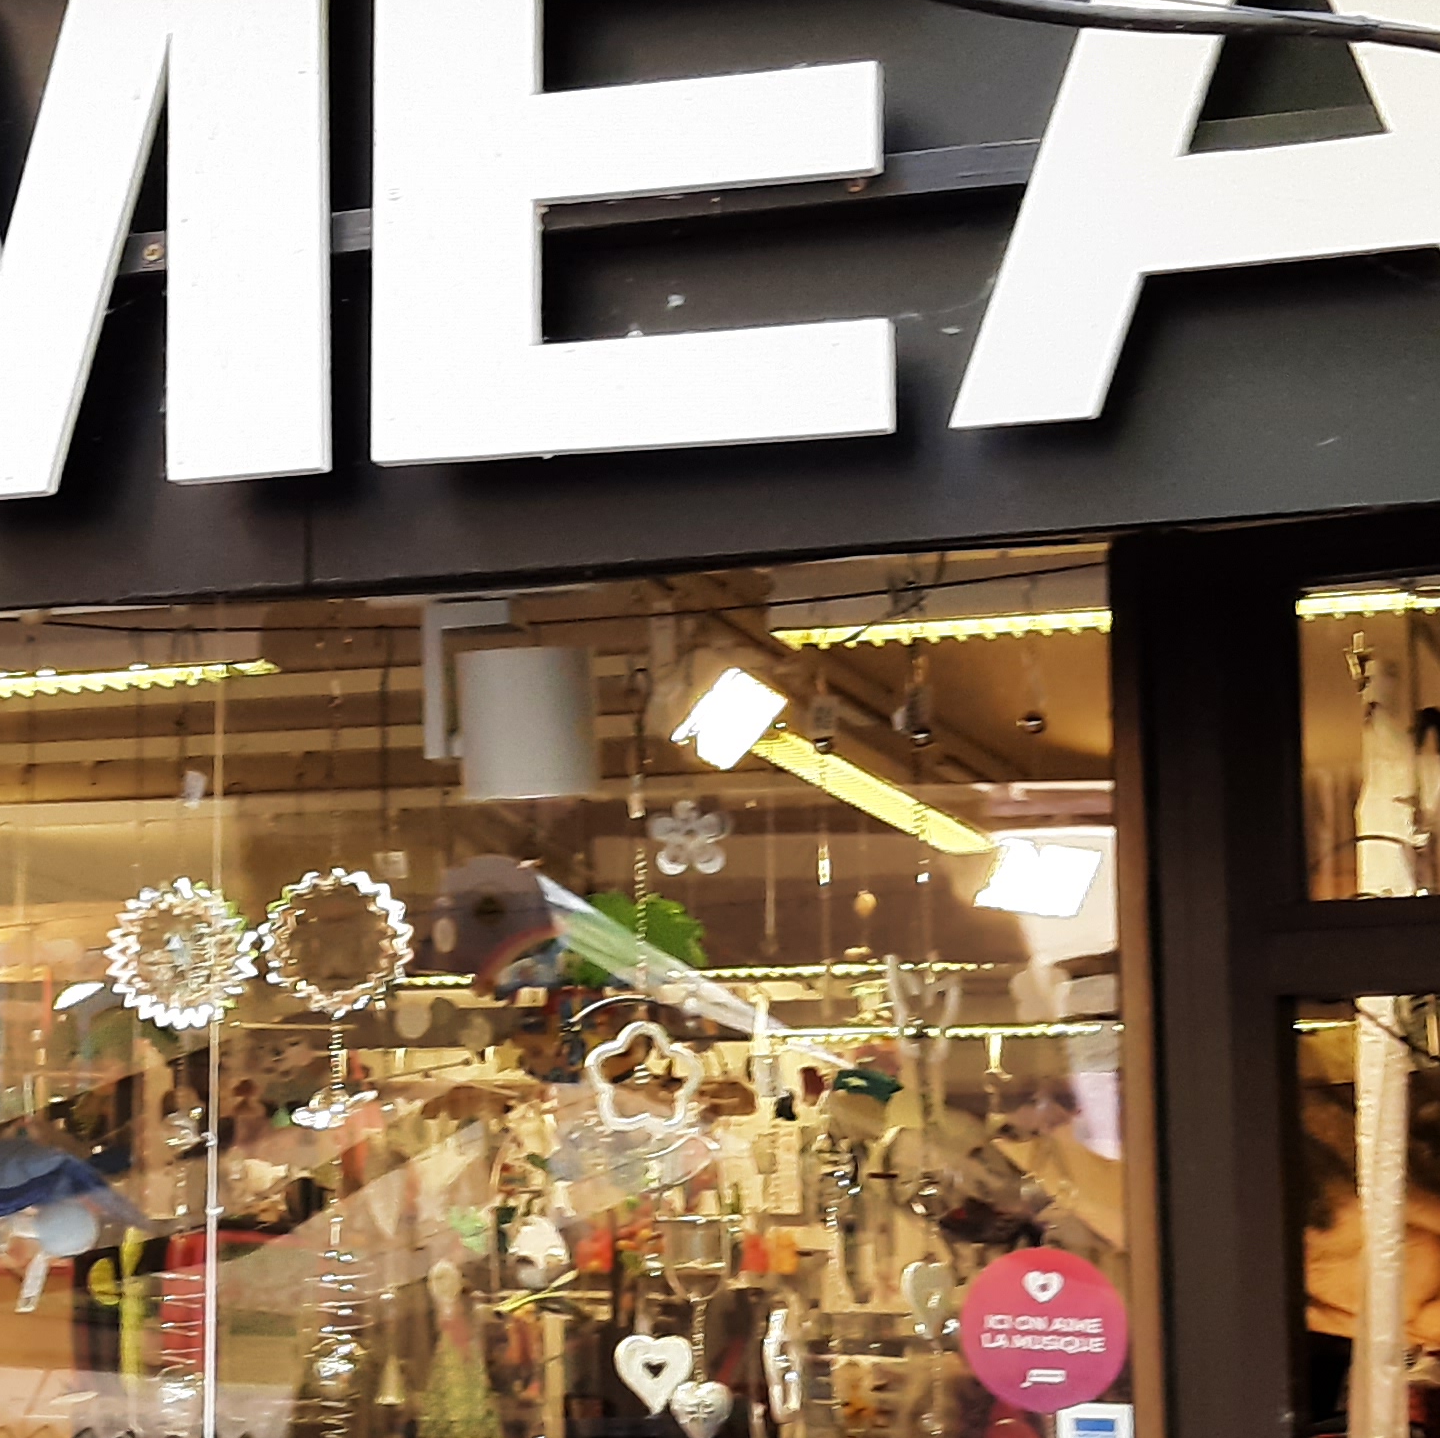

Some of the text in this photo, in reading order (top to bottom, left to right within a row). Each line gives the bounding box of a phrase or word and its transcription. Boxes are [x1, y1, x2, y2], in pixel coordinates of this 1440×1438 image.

[983, 1313, 1104, 1335] ICI ON AIME
[980, 1332, 1108, 1354] LA MUSIQUE
